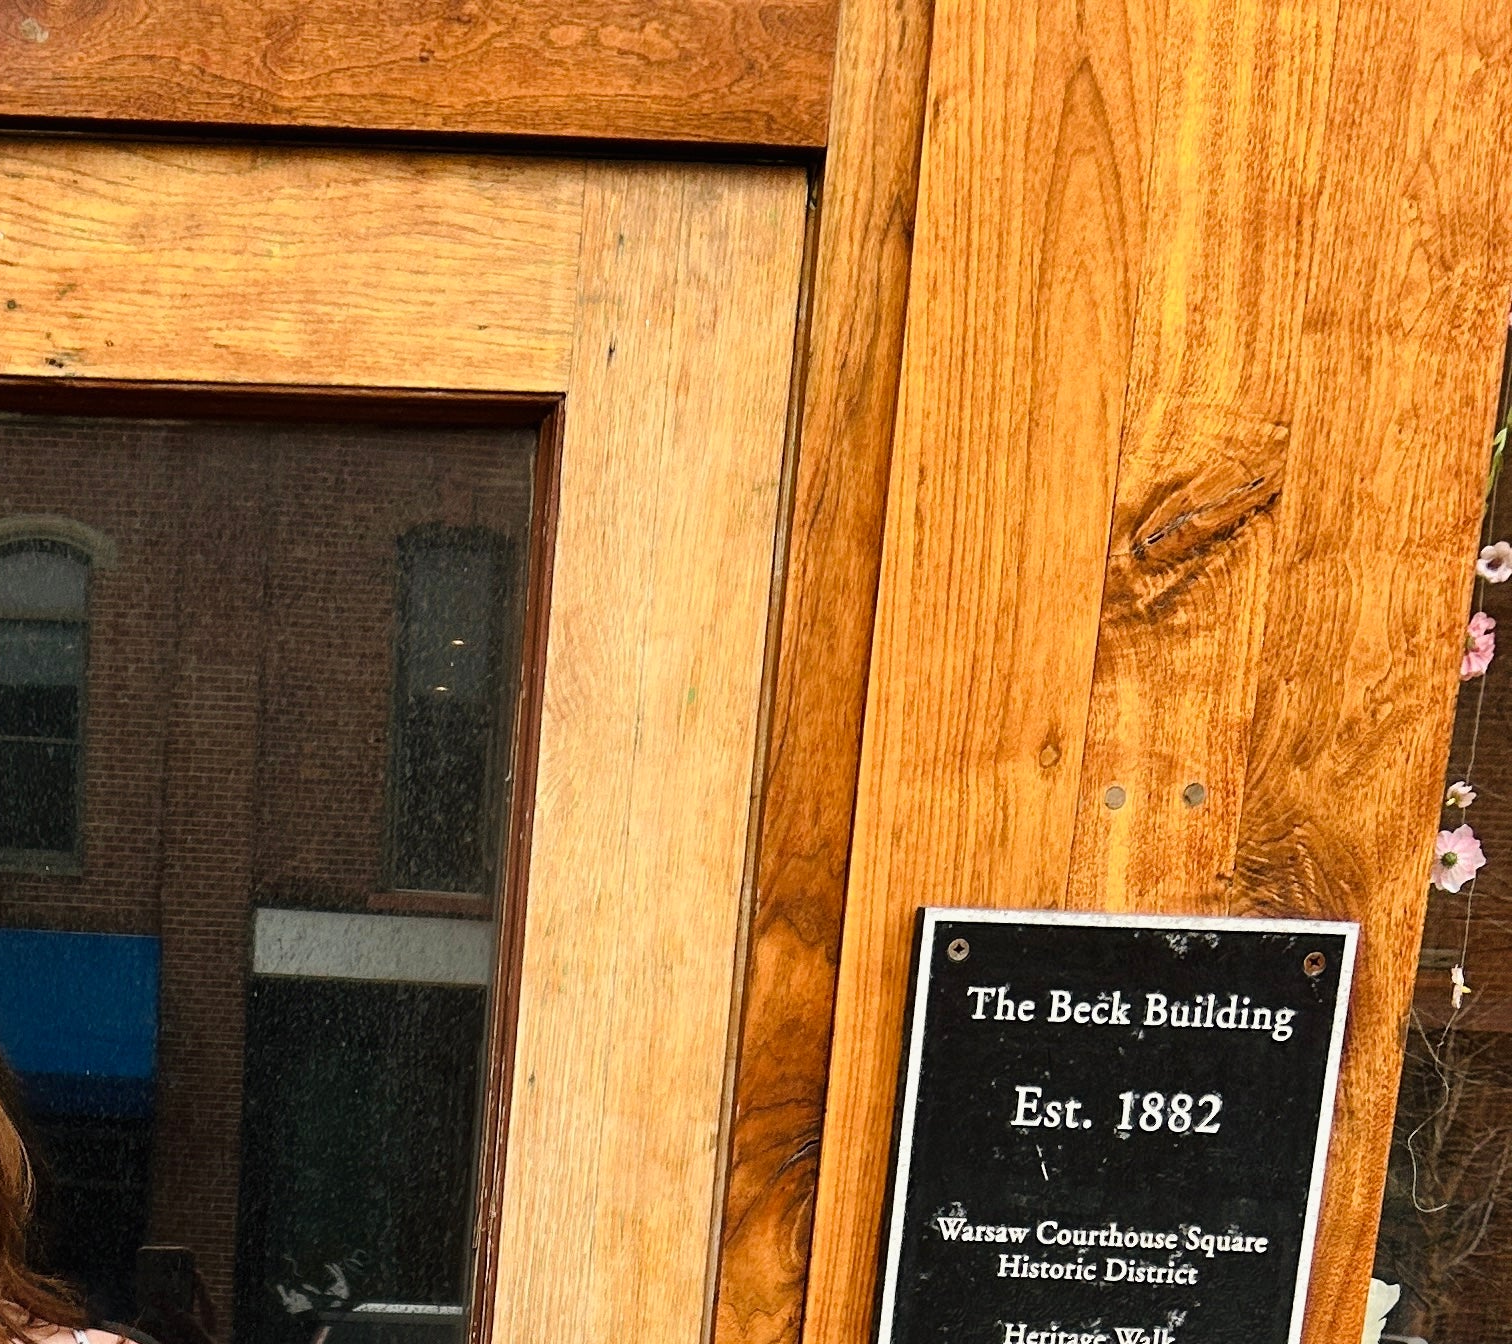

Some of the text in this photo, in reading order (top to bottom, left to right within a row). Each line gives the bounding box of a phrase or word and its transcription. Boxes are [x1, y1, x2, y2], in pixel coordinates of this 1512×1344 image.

[966, 986, 1296, 1041] The Beck Building
[1010, 1086, 1223, 1134] Est. 1882
[937, 1217, 1269, 1256] Warsaw Courthouse Square
[997, 1254, 1199, 1285] Historic District
